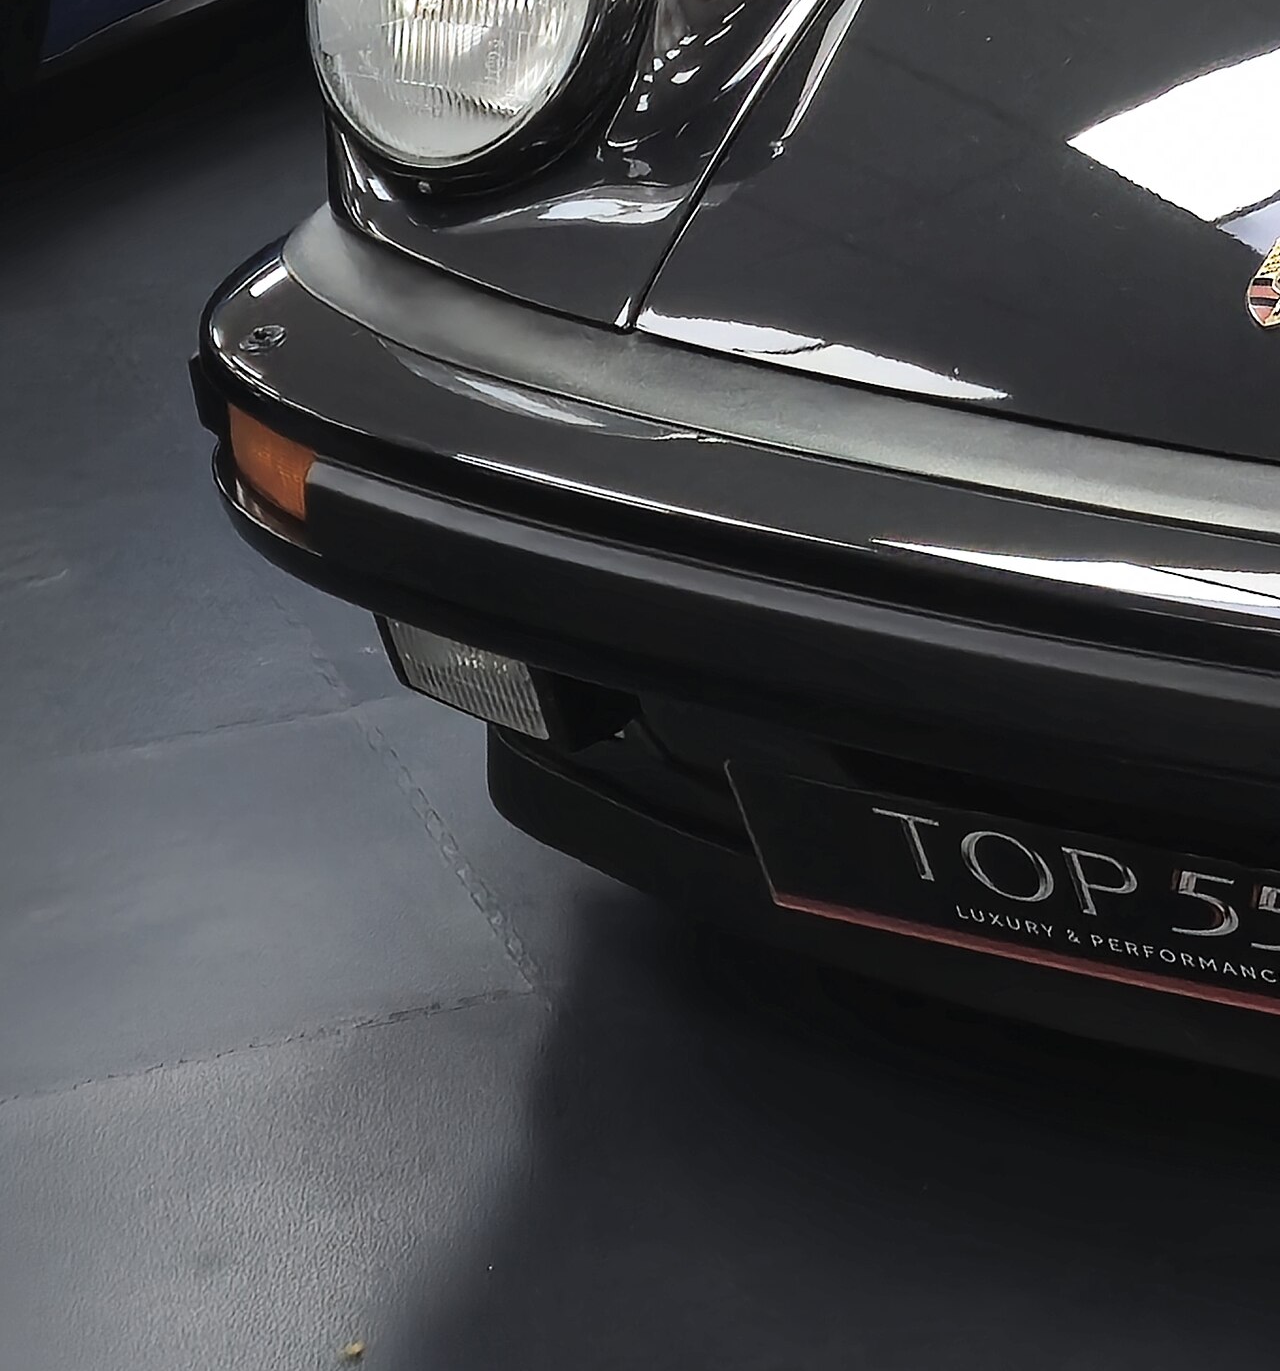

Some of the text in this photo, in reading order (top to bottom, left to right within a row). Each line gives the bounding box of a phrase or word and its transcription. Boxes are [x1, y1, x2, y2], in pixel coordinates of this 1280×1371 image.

[872, 806, 1137, 916] TOP
[955, 904, 1053, 938] LUXURY
[1066, 929, 1081, 944] &
